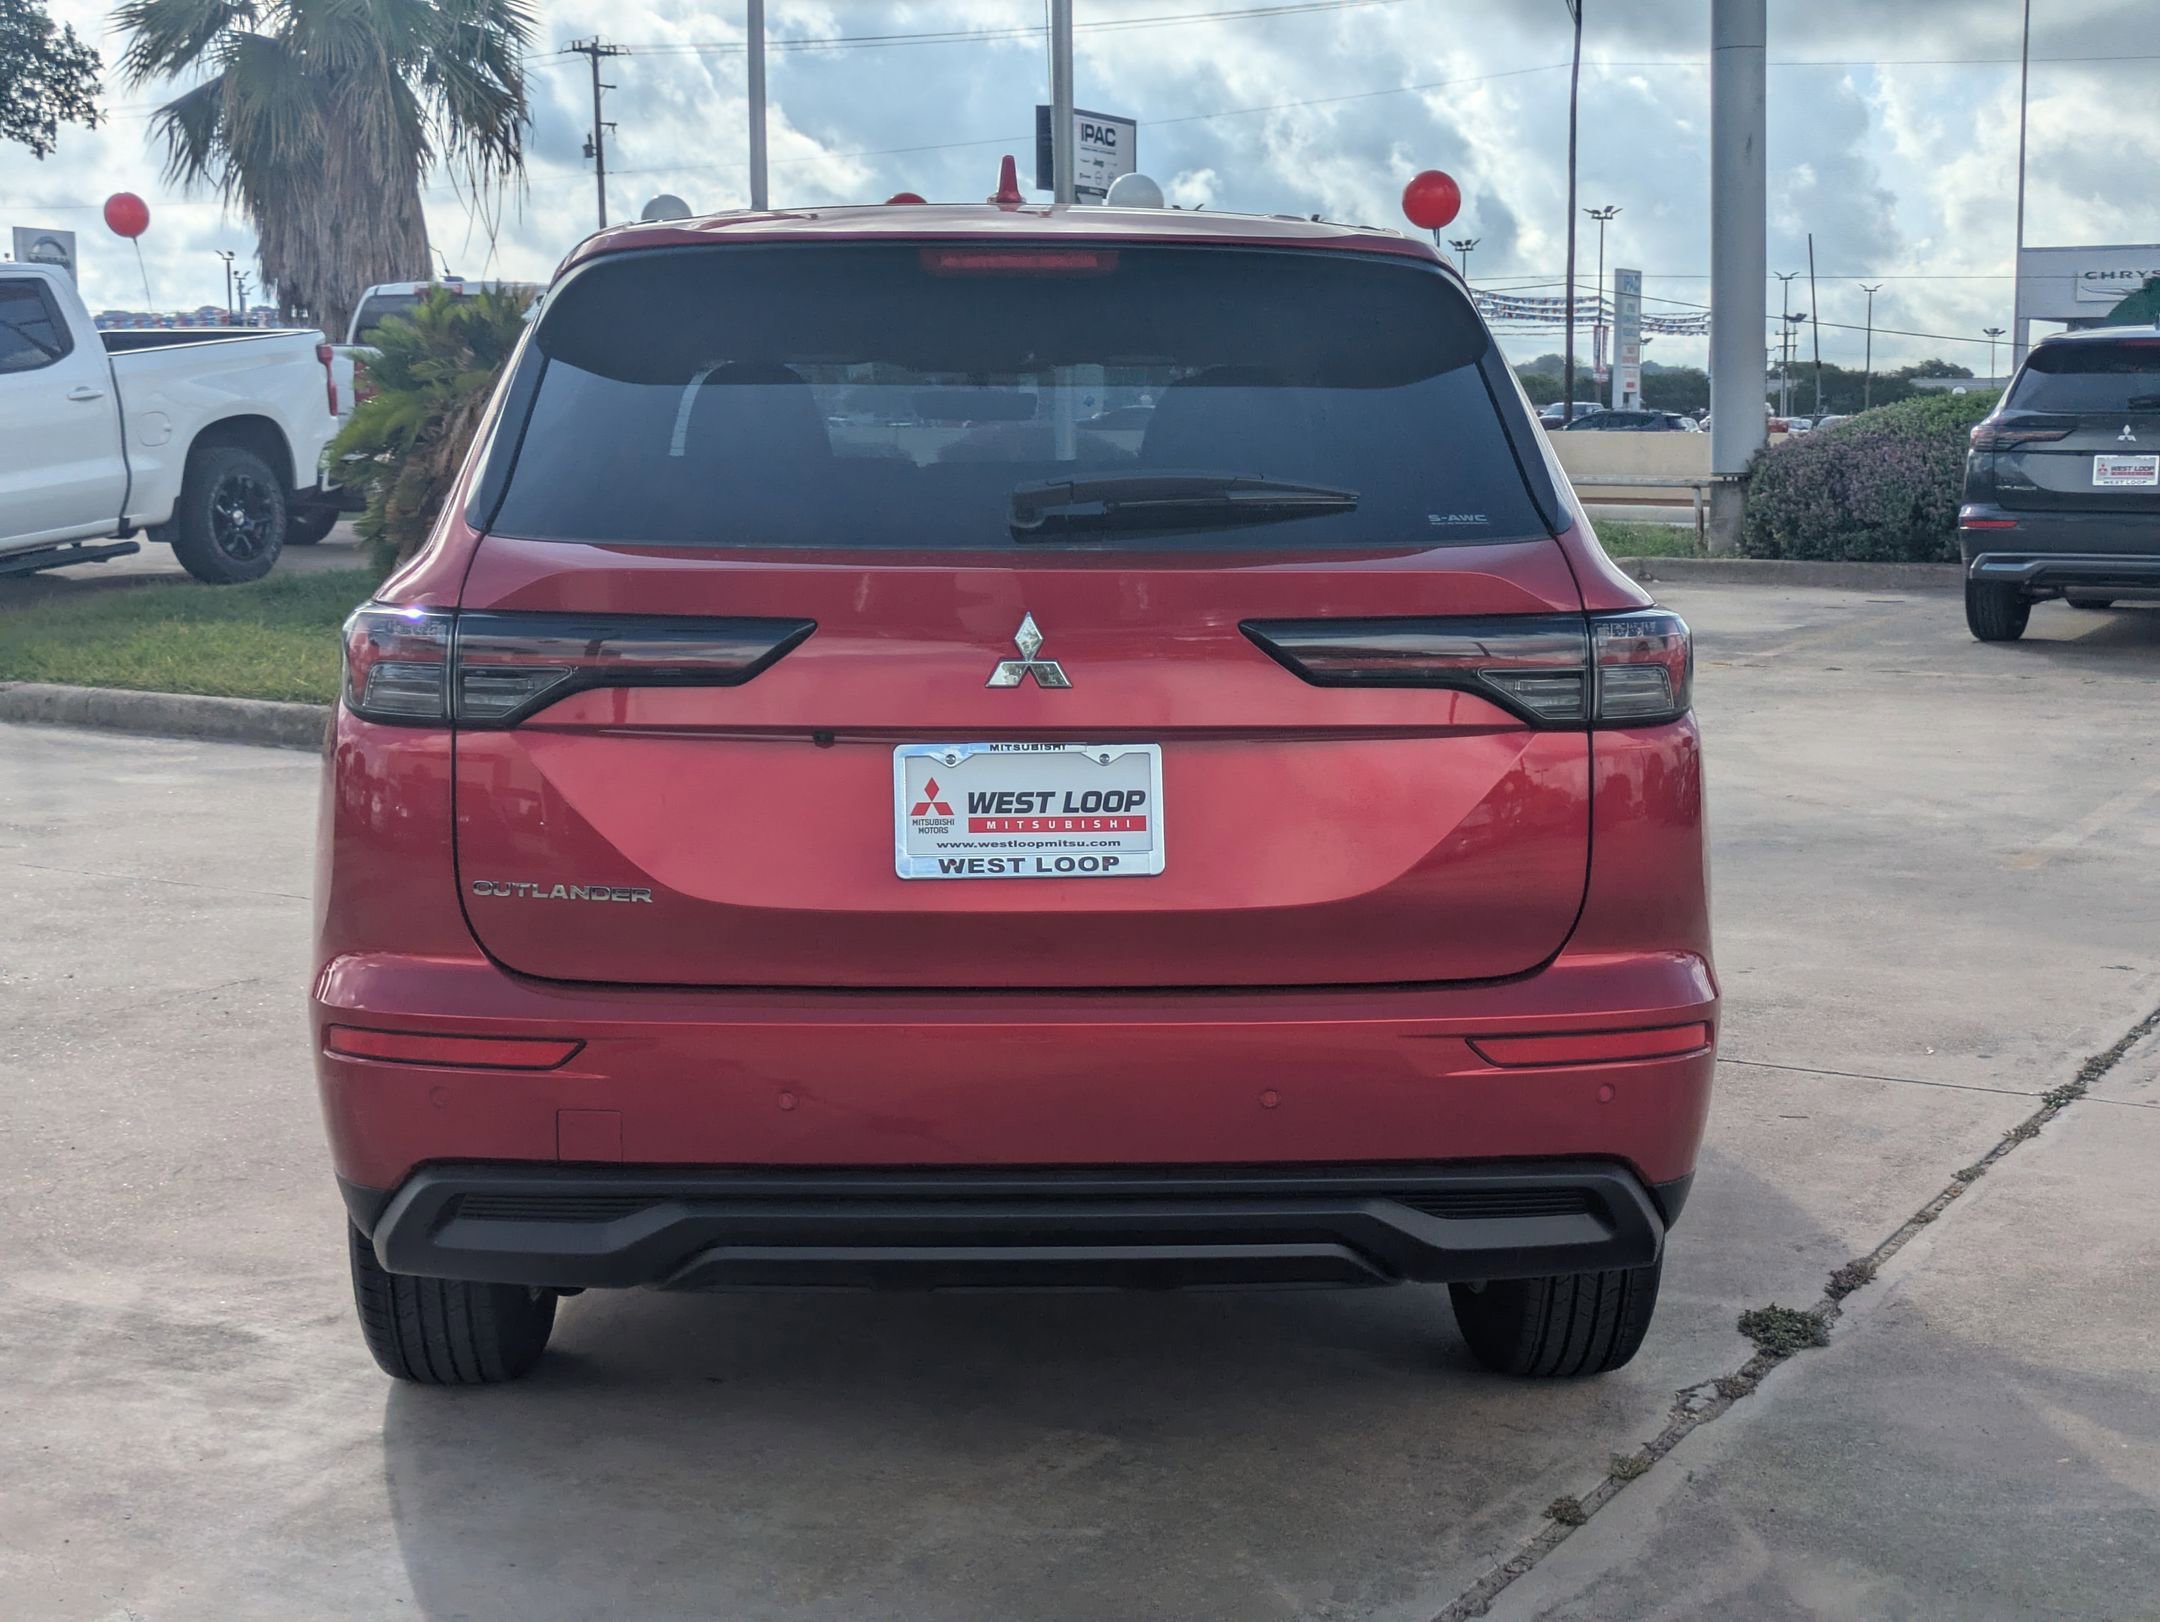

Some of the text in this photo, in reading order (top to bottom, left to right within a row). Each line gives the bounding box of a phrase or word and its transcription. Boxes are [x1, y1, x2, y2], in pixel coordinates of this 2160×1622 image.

[1081, 122, 1116, 147] IPAC
[1428, 514, 1488, 522] S-AWC
[989, 743, 1067, 752] MITSUBISHI
[967, 790, 1146, 814] WEST LOOP
[911, 818, 955, 827] MITSUBISHI
[986, 820, 1132, 830] MITSUBISHI
[918, 827, 949, 835] MOTORS
[936, 839, 1121, 849] www.westloopmitsu.com
[938, 856, 1120, 874] WEST LOOP
[472, 880, 653, 903] OUTLANDER
